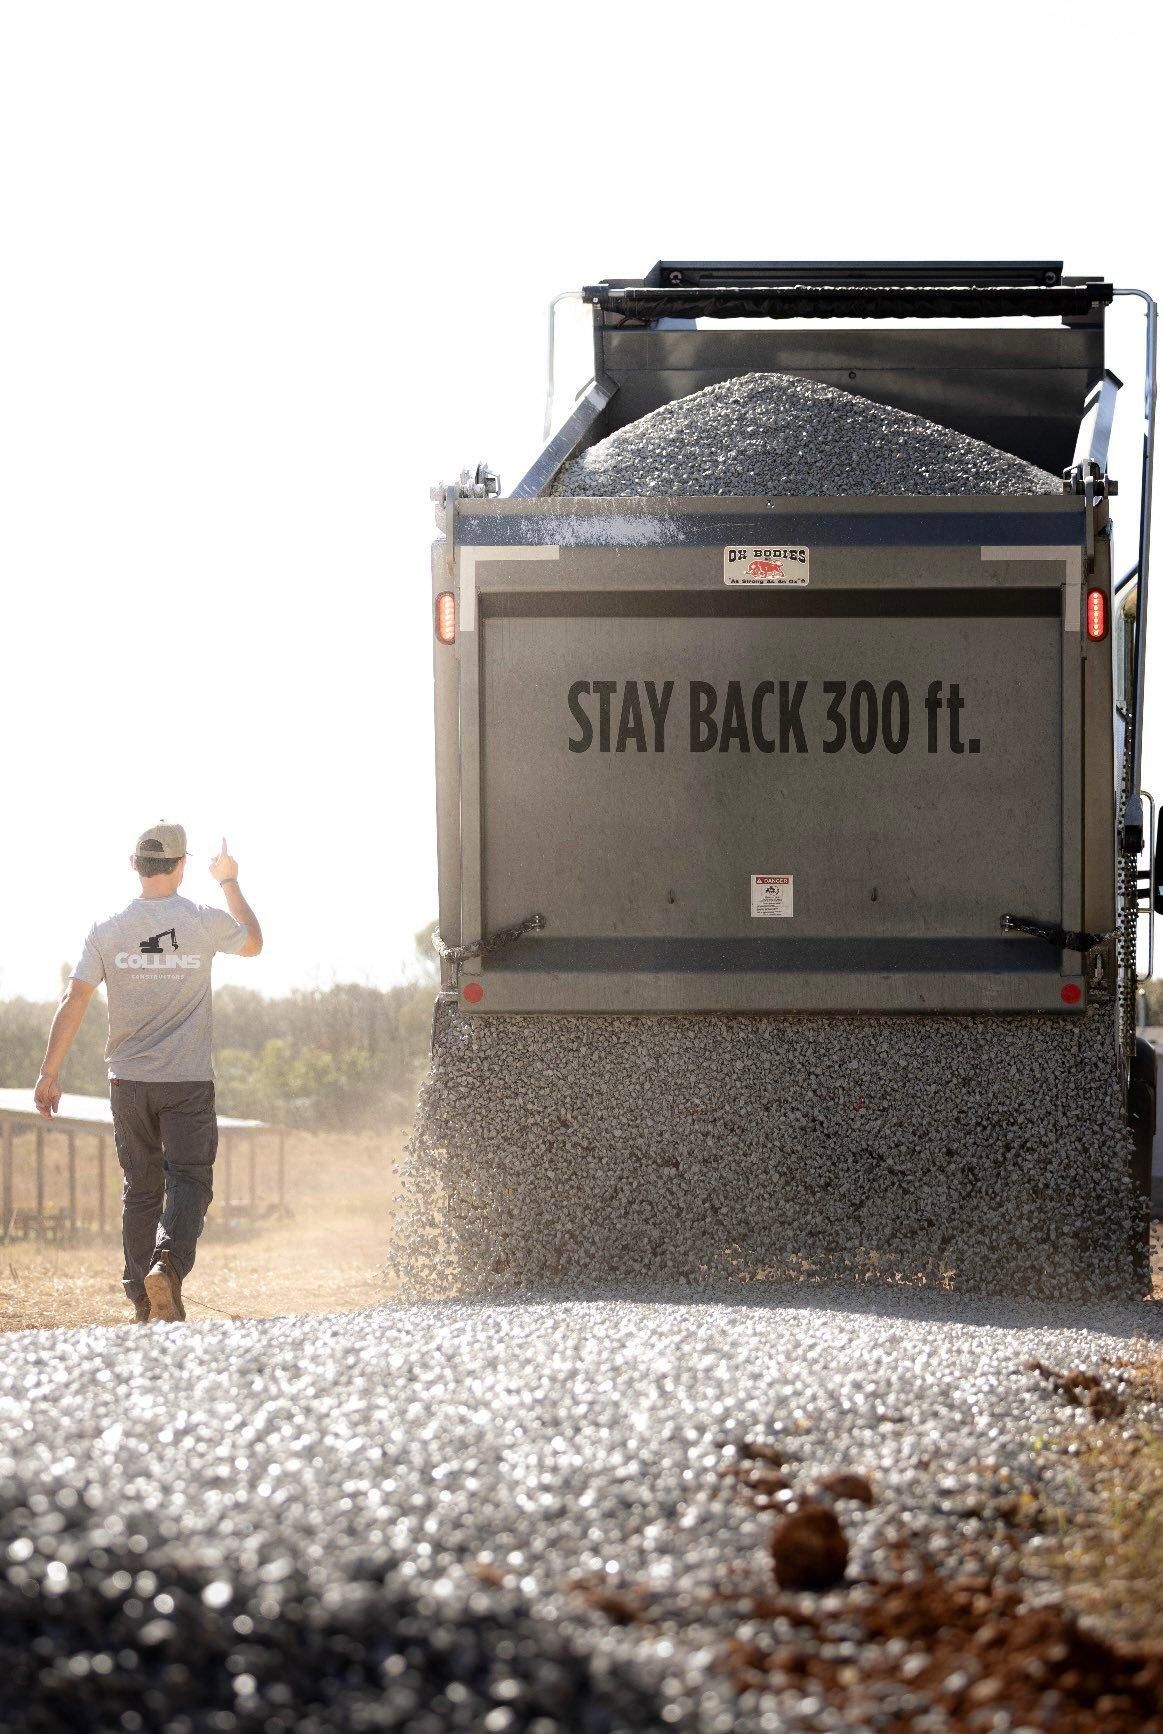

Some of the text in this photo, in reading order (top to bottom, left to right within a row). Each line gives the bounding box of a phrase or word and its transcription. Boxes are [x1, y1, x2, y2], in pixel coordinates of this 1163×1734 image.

[728, 549, 806, 564] OX BODIES
[567, 679, 981, 755] STAY BACK 300 ft.
[115, 952, 201, 969] COLLINS
